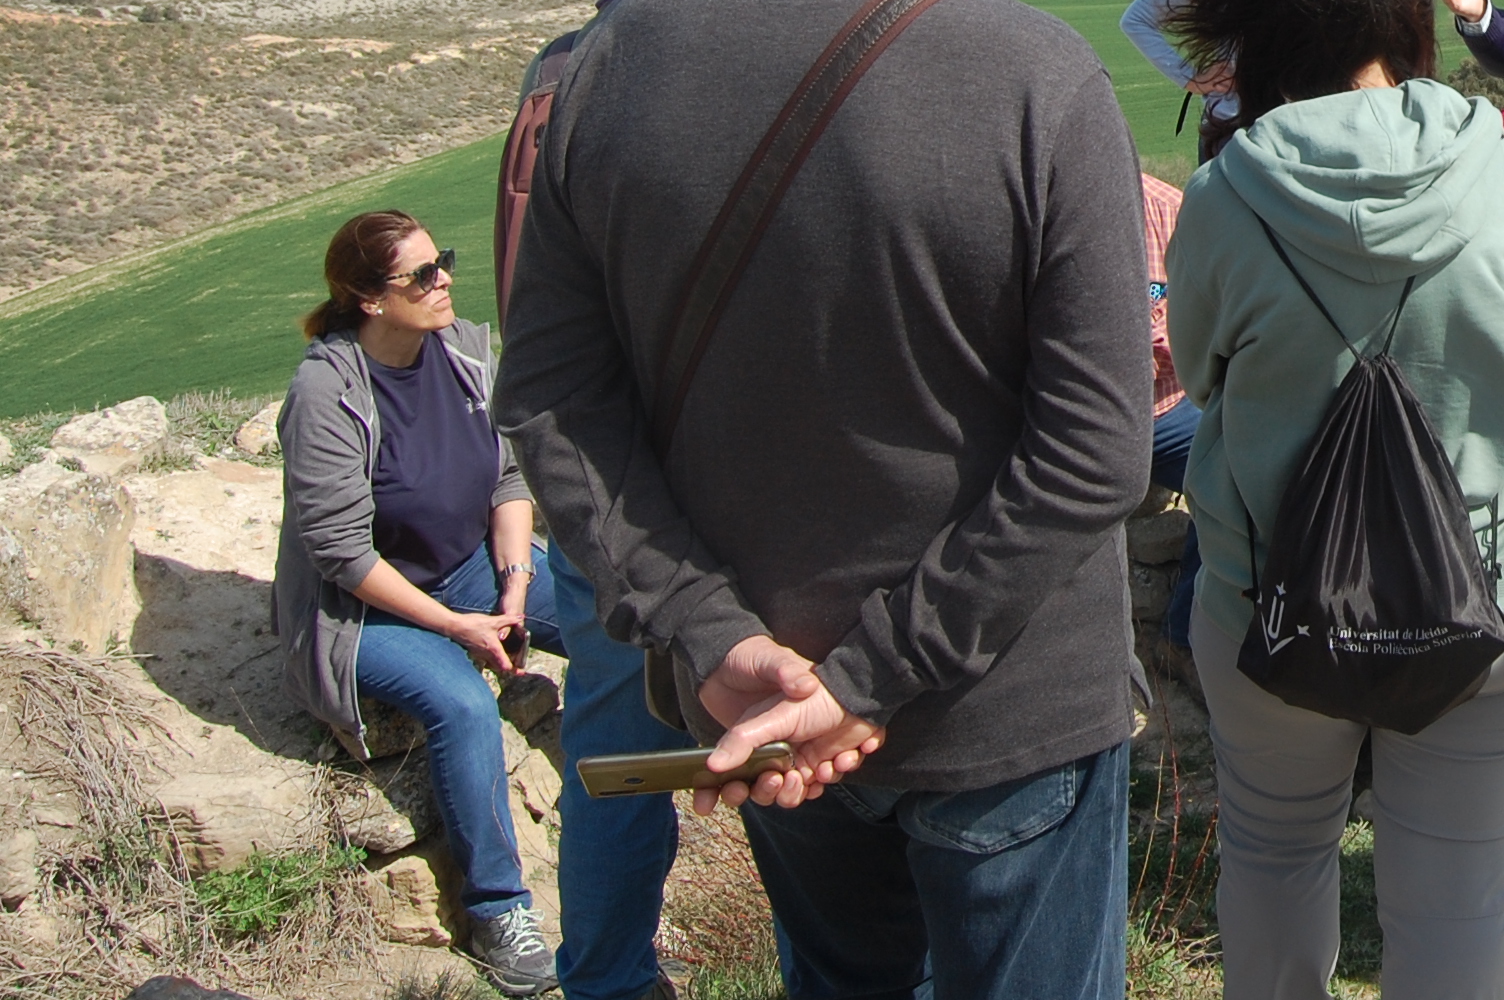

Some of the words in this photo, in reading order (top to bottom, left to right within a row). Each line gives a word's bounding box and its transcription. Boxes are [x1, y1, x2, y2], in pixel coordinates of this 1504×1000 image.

[1329, 626, 1399, 640] Universitat
[1402, 628, 1413, 640] de
[1415, 626, 1449, 640] Lleida
[1329, 638, 1368, 653] Escola
[1373, 642, 1430, 655] Politècnica
[1432, 629, 1483, 648] Superior
